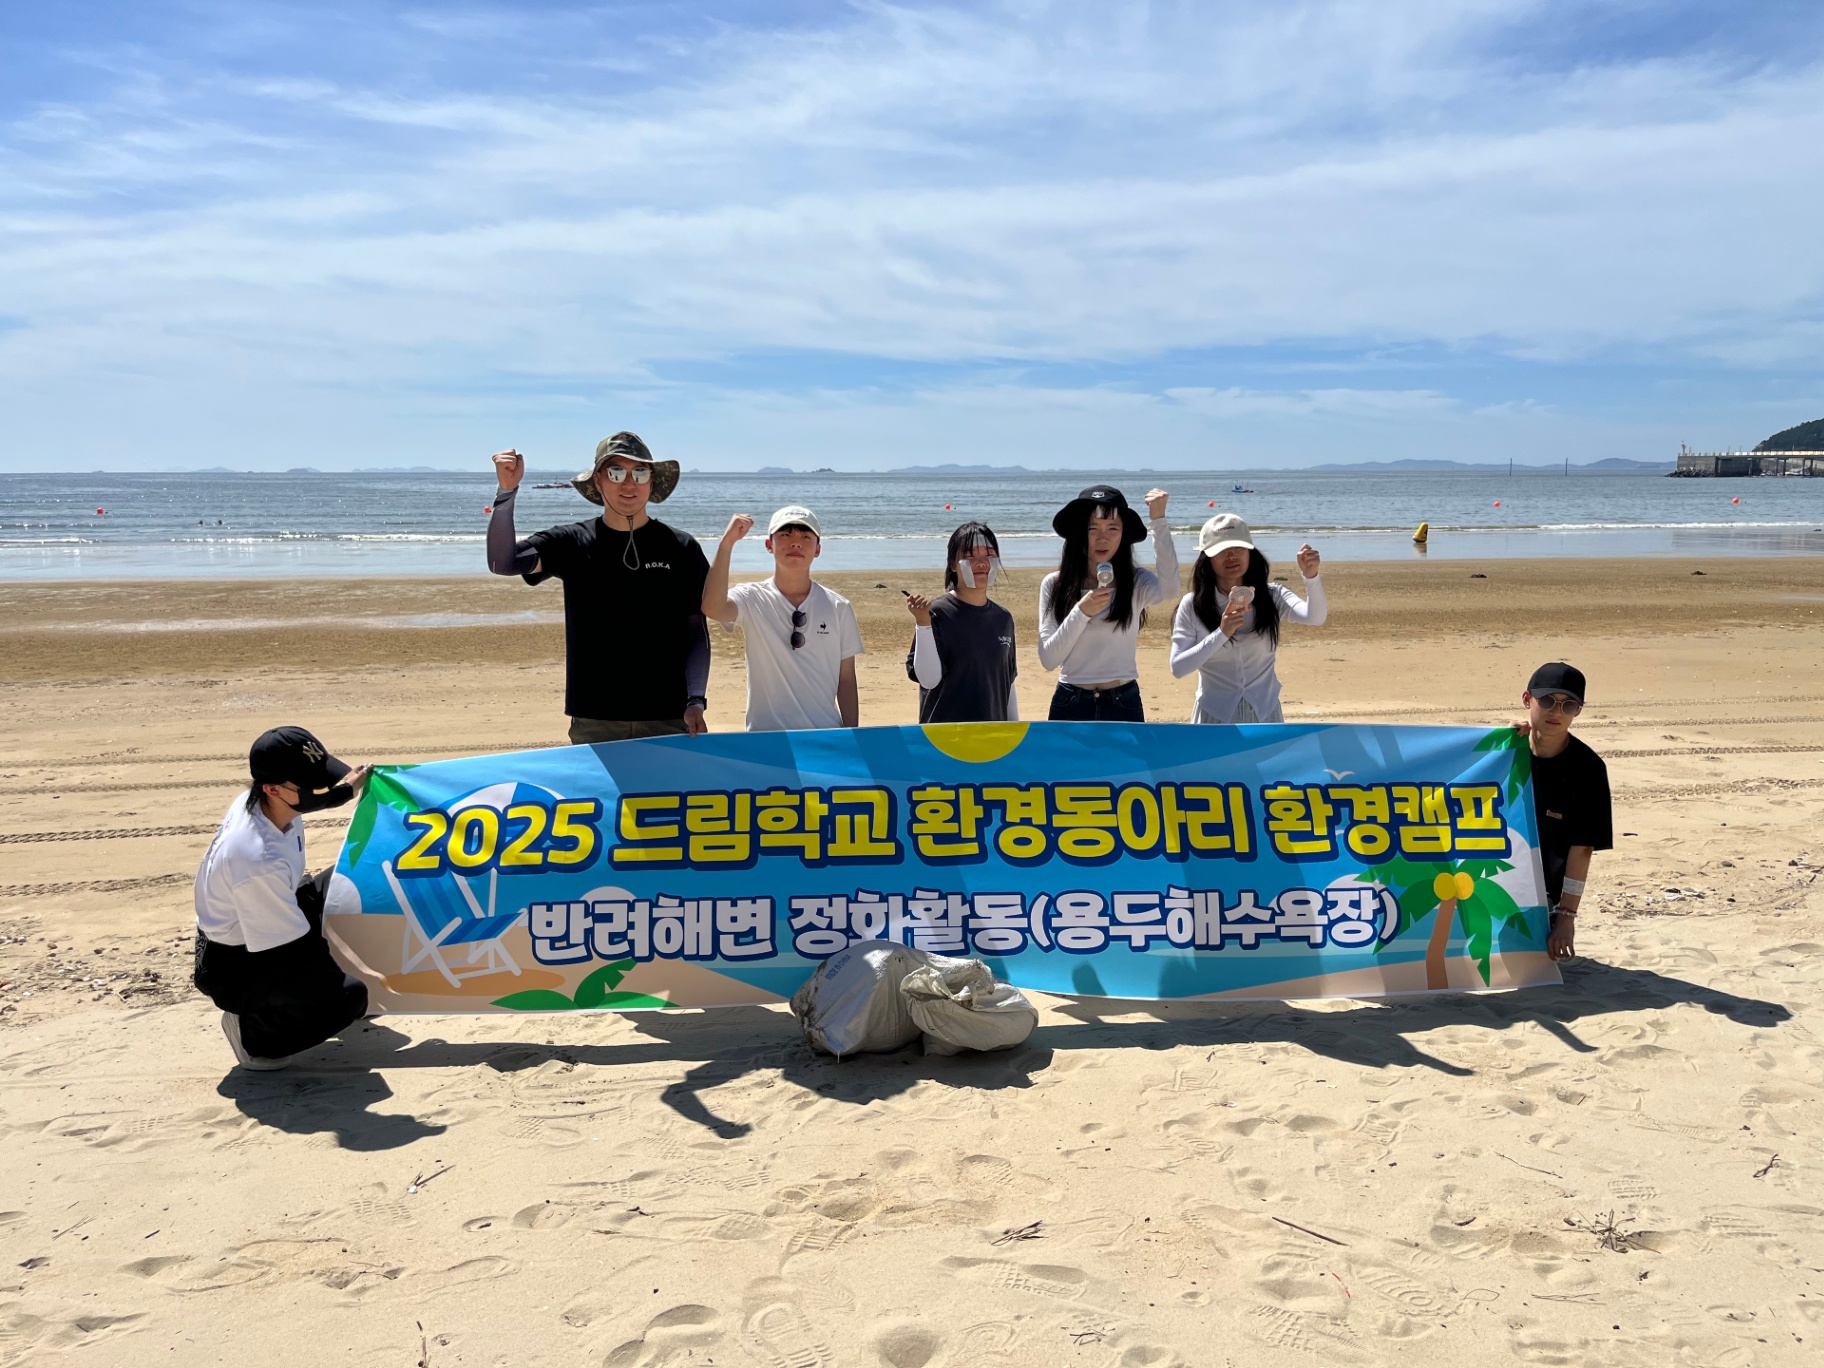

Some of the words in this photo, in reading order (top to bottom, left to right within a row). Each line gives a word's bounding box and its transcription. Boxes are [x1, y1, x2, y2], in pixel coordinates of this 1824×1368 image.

[302, 741, 324, 763] NY
[398, 801, 597, 870] 2025
[613, 789, 896, 862] 드림학교
[912, 786, 1250, 858] 환경동아리
[1267, 785, 1506, 856] 환경캠프
[531, 894, 772, 962] 반려해변
[790, 888, 1398, 954] 정화활동(용두해수욕장)
